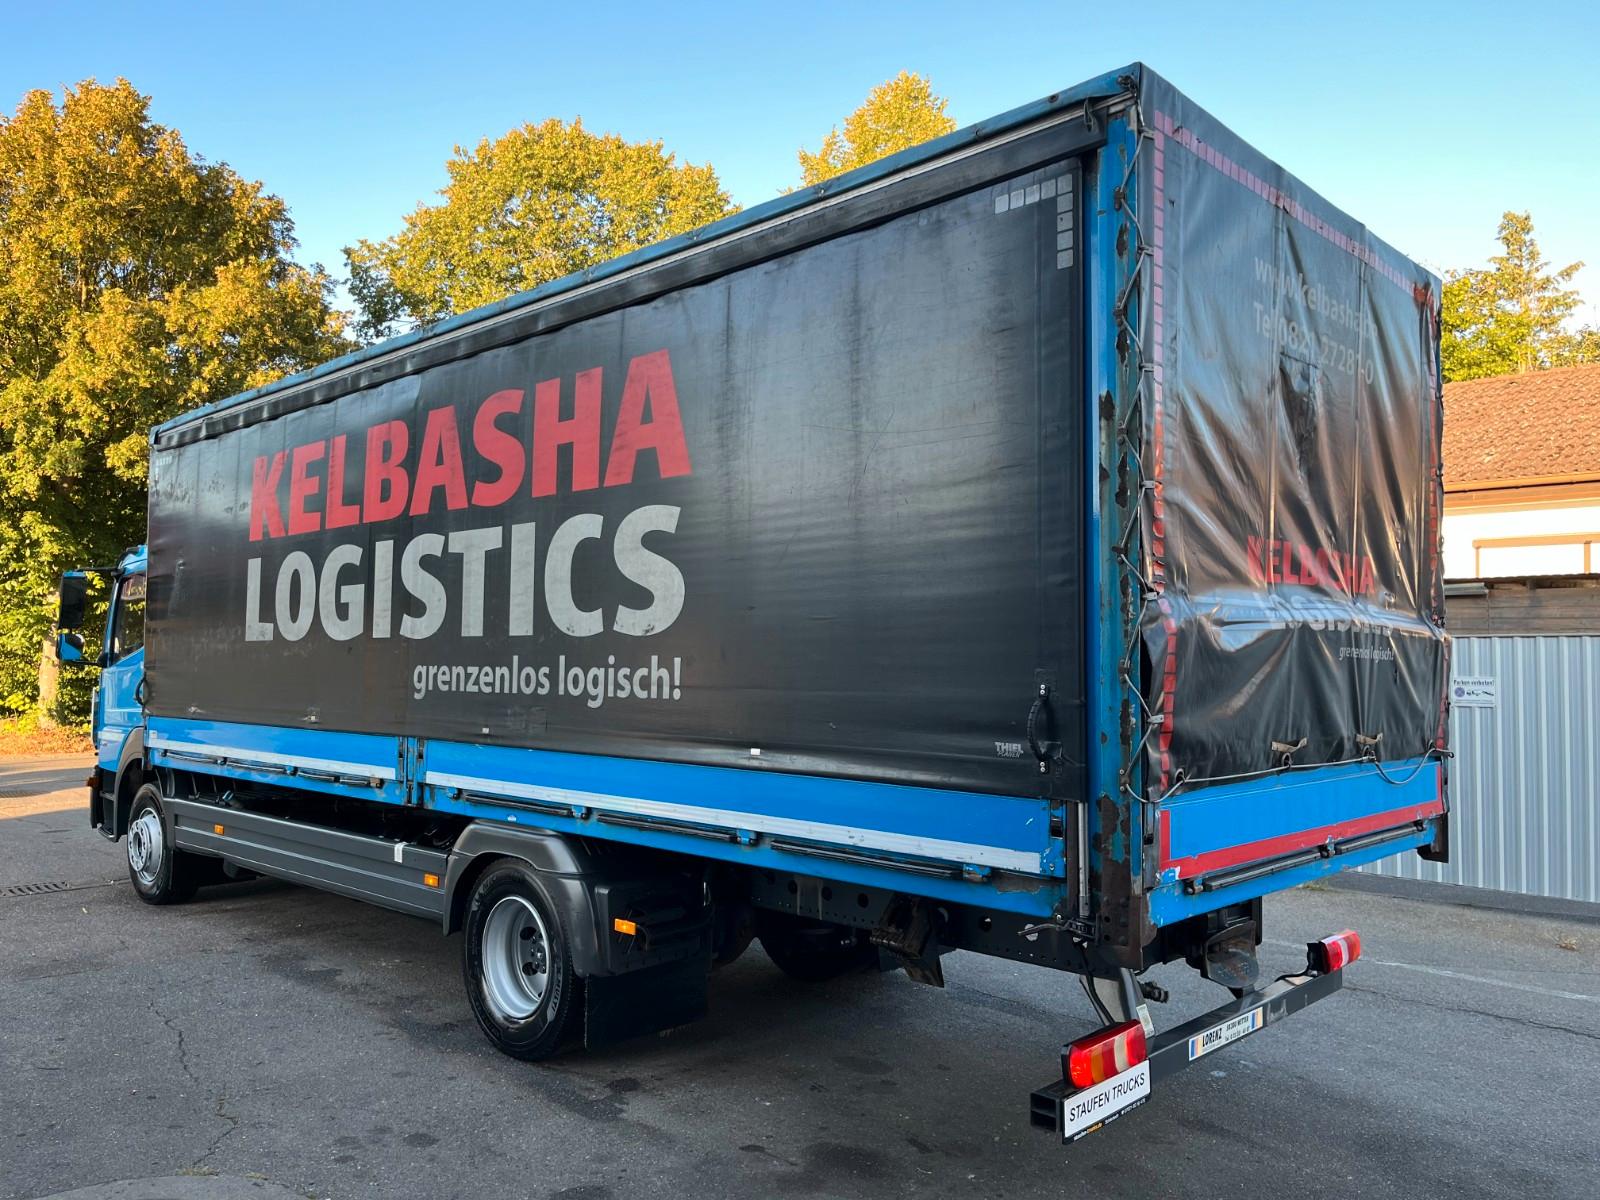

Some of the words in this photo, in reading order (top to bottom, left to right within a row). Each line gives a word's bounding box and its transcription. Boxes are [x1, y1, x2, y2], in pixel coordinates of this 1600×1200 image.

[1254, 256, 1378, 337] wwwkelbashade
[248, 348, 693, 542] KELBASHA
[244, 504, 686, 642] LOGISTICS
[413, 654, 550, 700] grenzenlos
[558, 654, 683, 709] logisch!
[1202, 1027, 1223, 1048] LORENZ
[1069, 1090, 1111, 1122] STAUFEN
[1112, 1072, 1145, 1100] TRUCKS
